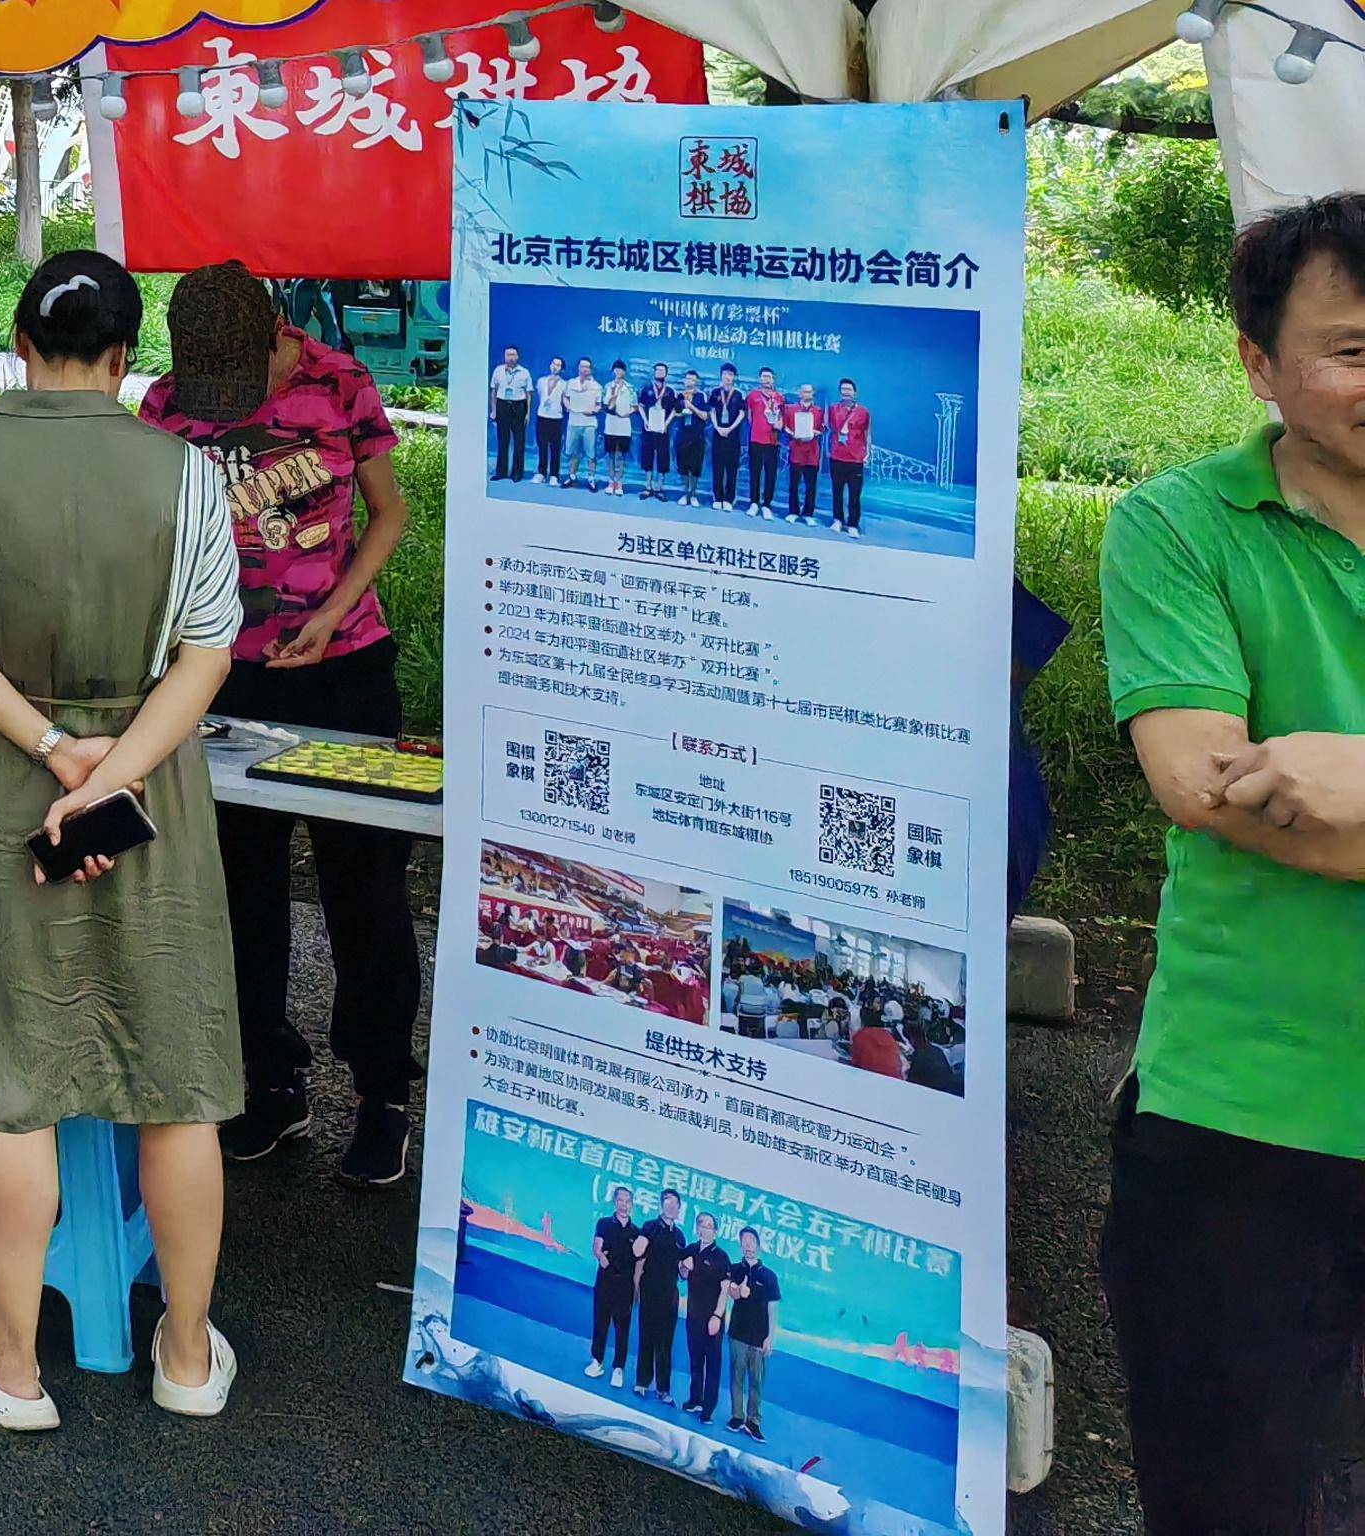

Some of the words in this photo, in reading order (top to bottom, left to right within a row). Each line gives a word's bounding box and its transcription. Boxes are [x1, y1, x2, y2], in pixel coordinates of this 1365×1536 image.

[687, 139, 754, 181] 東城
[491, 232, 980, 290] 北京市东城区棋牌运动协会简介
[617, 531, 821, 580] 为驻区单位和社区服务
[498, 624, 531, 642] 2024
[505, 740, 536, 762] 围棋
[505, 762, 536, 783] 象棋
[699, 773, 727, 793] 地址
[634, 783, 792, 828] 东城区安定门外大街116号
[519, 808, 595, 836] 13001271540
[907, 822, 944, 846] 国际
[906, 846, 943, 870] 象棋
[789, 868, 879, 900] 18519005975
[645, 1027, 768, 1082] 提供技术支持
